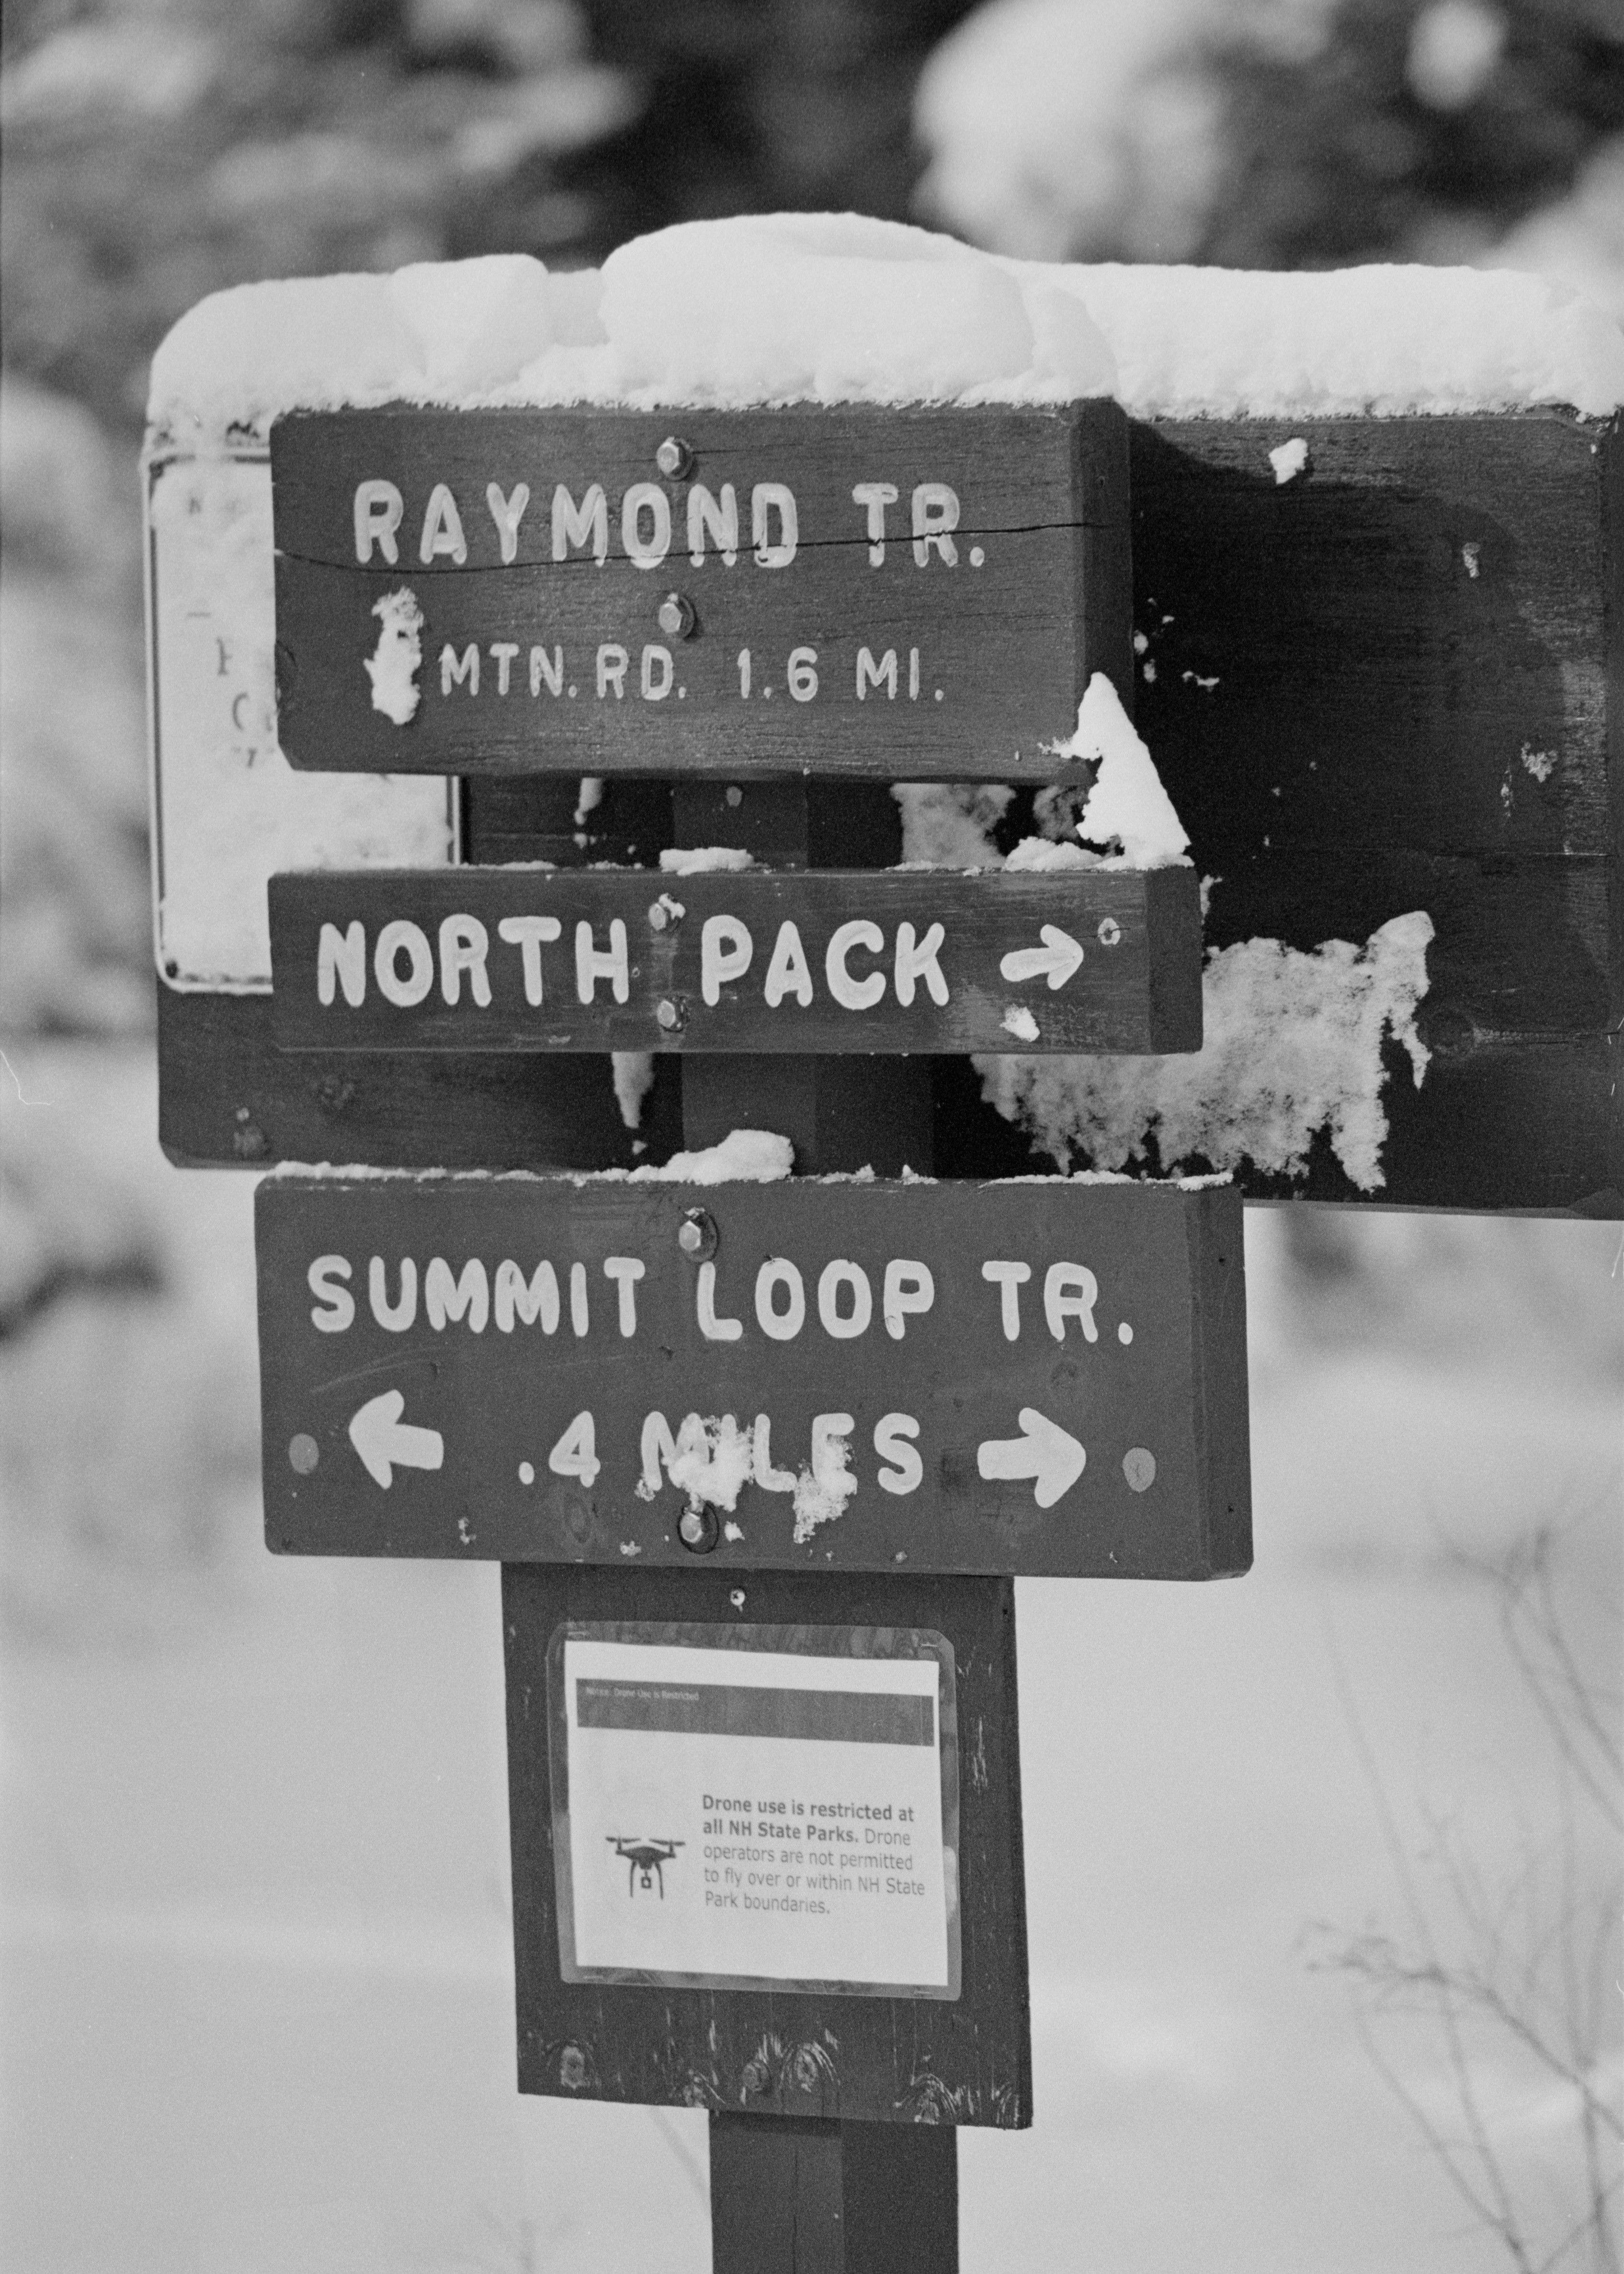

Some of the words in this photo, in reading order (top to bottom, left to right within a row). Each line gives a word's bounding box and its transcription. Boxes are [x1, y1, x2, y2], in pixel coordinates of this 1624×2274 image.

[353, 479, 799, 571] RAYMOND
[851, 482, 985, 568] TR.
[736, 646, 819, 703] 1.6
[855, 646, 944, 702] MI.
[317, 914, 630, 1008] NORTH
[701, 914, 950, 1011] PACK
[307, 1254, 647, 1339] SUMMIT
[696, 1257, 935, 1342] LOOP
[981, 1260, 1134, 1346] TR.
[518, 1410, 602, 1489] .4
[703, 1794, 752, 1813] Drone
[758, 1800, 787, 1815] use
[792, 1798, 805, 1816] is
[810, 1802, 892, 1820] restricted
[898, 1806, 915, 1822] at
[703, 1819, 723, 1835] all
[729, 1820, 752, 1837] NH
[758, 1821, 801, 1840] State
[806, 1824, 859, 1843] Parks.
[864, 1828, 911, 1846] Drone
[703, 1844, 775, 1863] operators
[780, 1850, 804, 1864] are
[809, 1851, 834, 1866] not
[840, 1852, 913, 1870] permitted
[704, 1867, 719, 1883] to
[725, 1867, 743, 1888] fly
[748, 1872, 781, 1887] over
[785, 1876, 802, 1888] or
[806, 1873, 852, 1892] within
[858, 1876, 880, 1893] NH
[886, 1877, 925, 1896] State
[705, 1890, 738, 1908] Park
[744, 1893, 830, 1915] boundaries.
